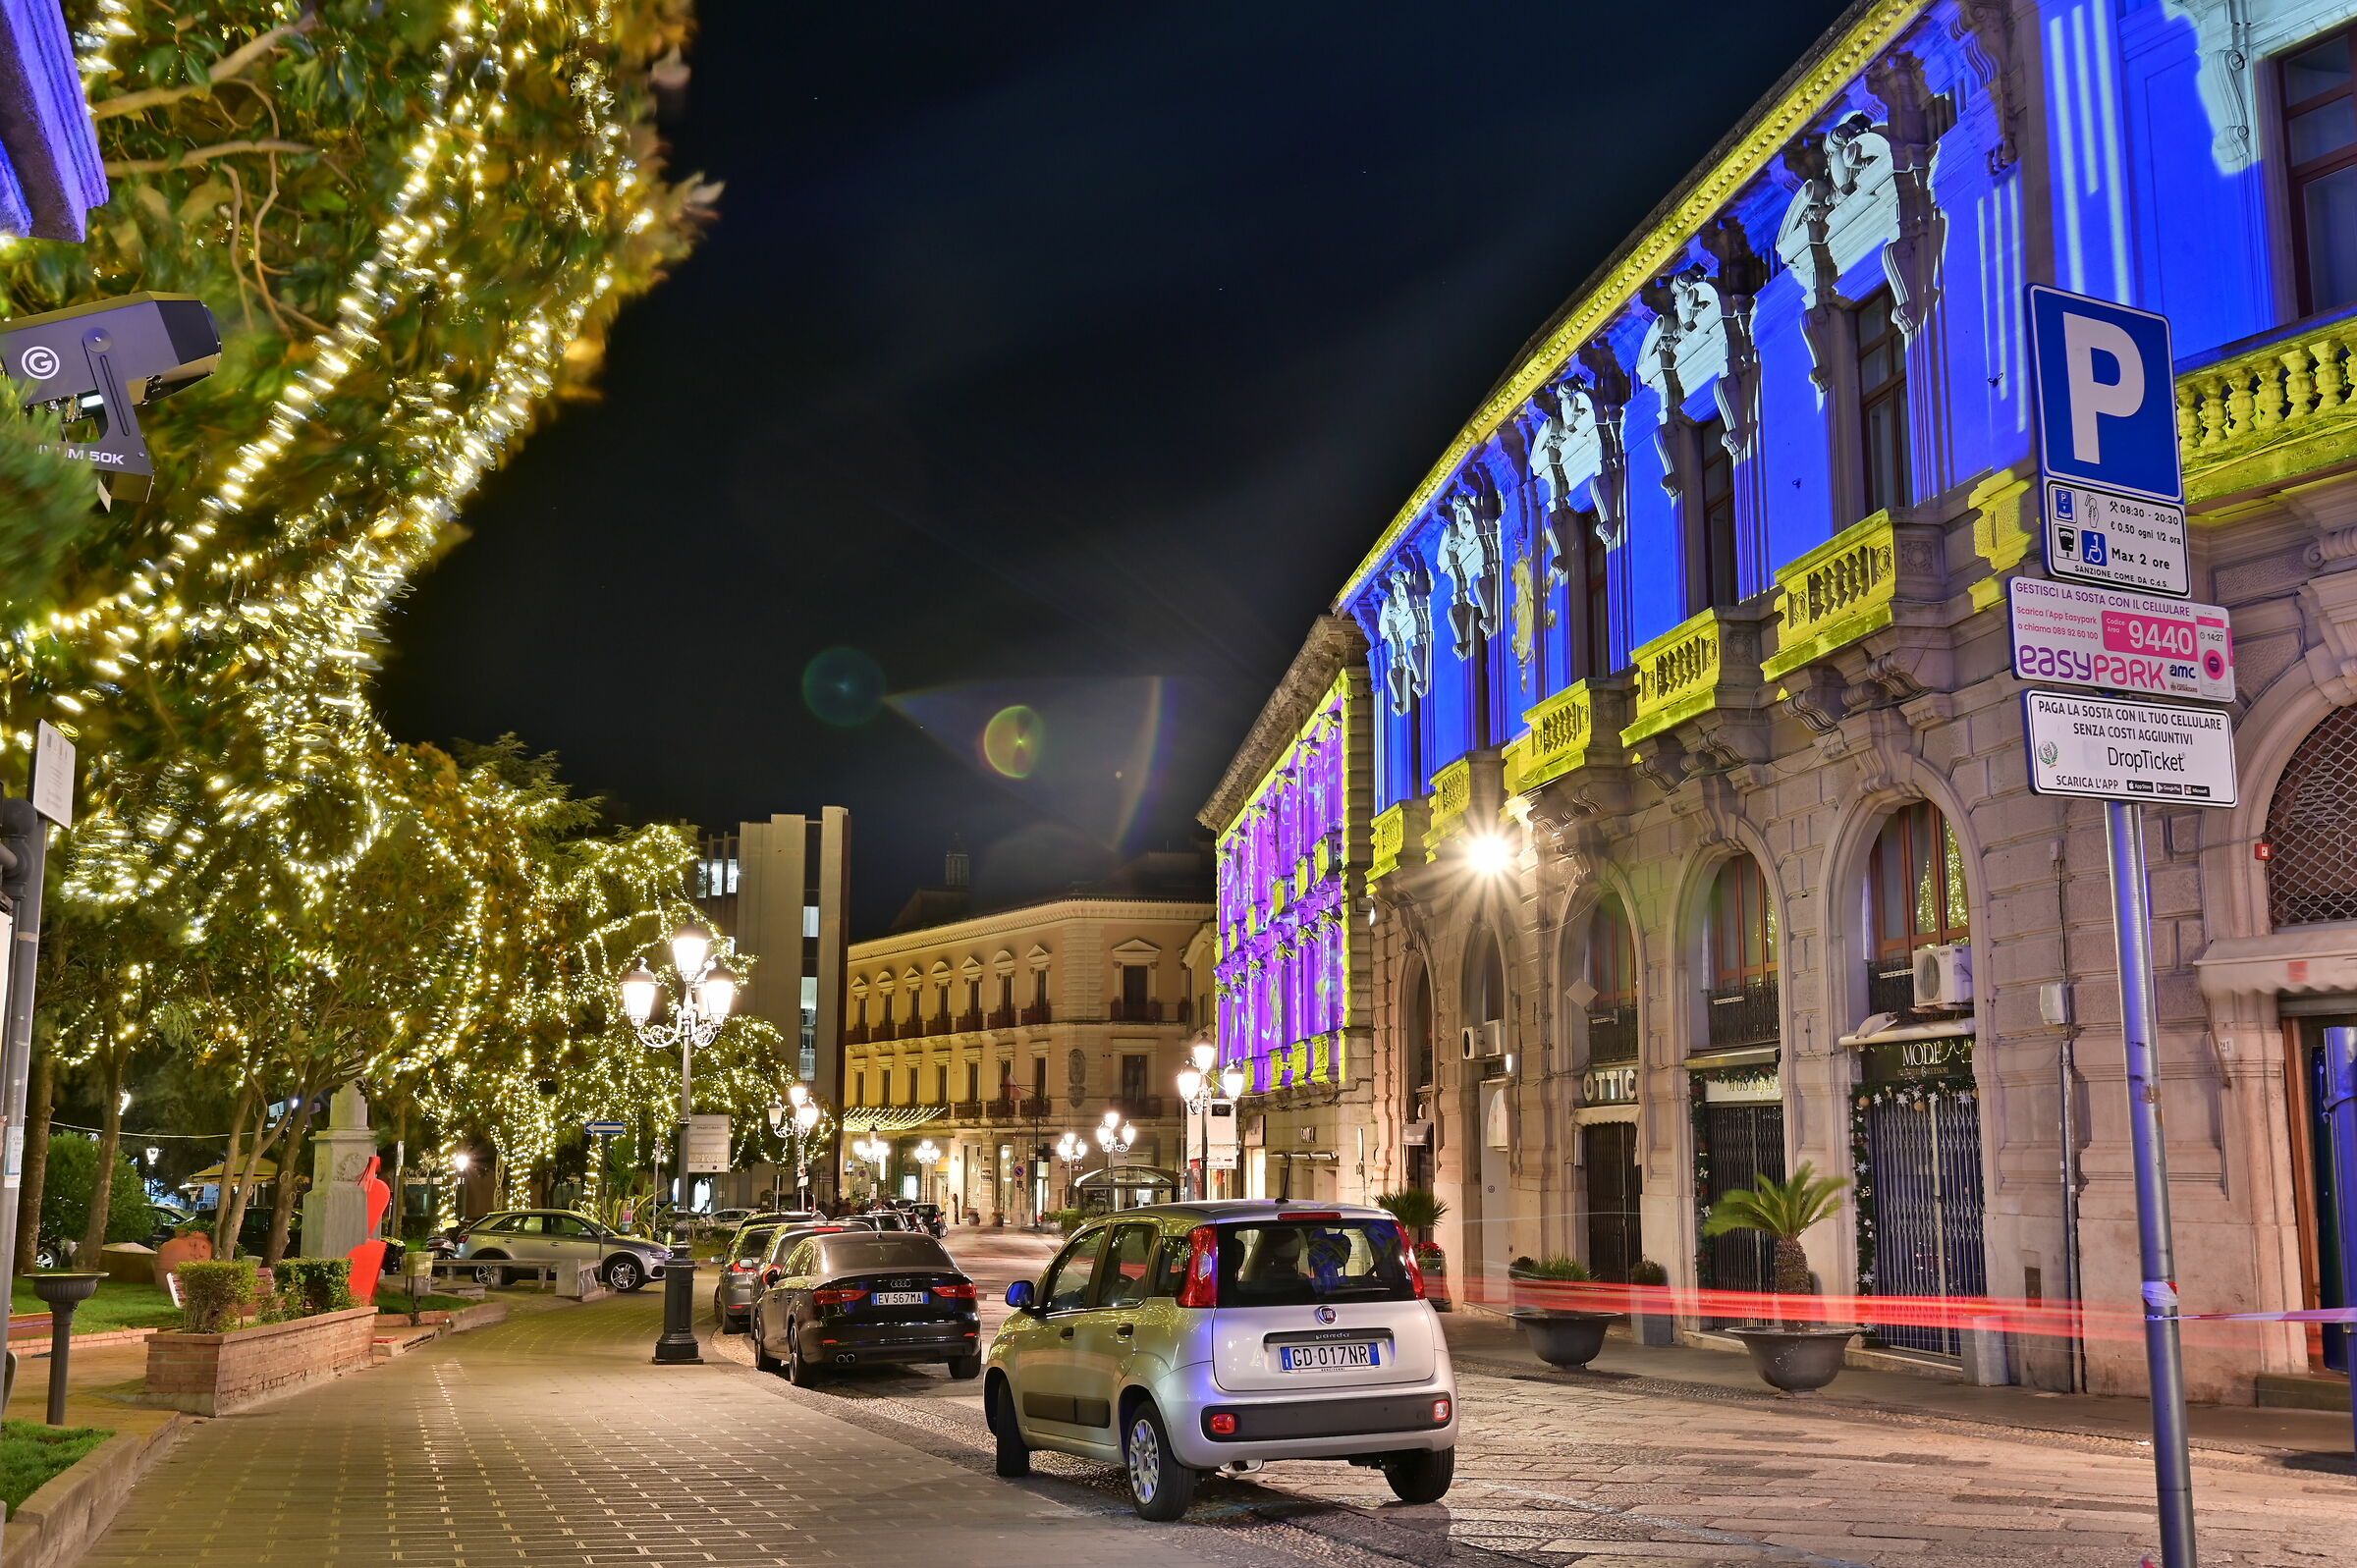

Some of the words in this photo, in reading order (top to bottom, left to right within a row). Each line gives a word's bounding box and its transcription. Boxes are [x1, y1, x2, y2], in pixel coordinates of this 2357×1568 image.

[2062, 311, 2145, 464] P
[89, 451, 125, 465] 50K
[2120, 504, 2145, 518] 08:30
[2154, 513, 2179, 525] 20:30
[2117, 522, 2135, 534] 0.50
[2138, 529, 2154, 539] ogni
[2157, 531, 2166, 542] 1/2
[2169, 536, 2181, 545] ora
[2111, 547, 2135, 564] Max
[2139, 553, 2147, 566] 2
[2153, 559, 2170, 569] ore
[2074, 565, 2111, 578] SANZIONE
[2114, 570, 2135, 582] COME
[2137, 575, 2148, 585] DA
[2150, 578, 2169, 588] C.d.S.
[2015, 582, 2059, 598] GESTISCI
[2061, 589, 2073, 600] LA
[2075, 591, 2106, 605] SOSTA
[2109, 596, 2130, 609] CON
[2133, 599, 2140, 610] IL
[2142, 601, 2190, 617] CELLULARE
[2016, 606, 2044, 617] Scarica
[2046, 609, 2063, 621] l'App
[2065, 613, 2098, 624] Easypark
[2024, 623, 2052, 633] chiama
[2087, 631, 2099, 640] 100
[2128, 620, 2193, 655] 9440
[2169, 664, 2197, 679] amc
[2038, 700, 2065, 715] PAGA
[2067, 703, 2080, 717] LA
[2082, 705, 2113, 720] SOSTA
[2115, 709, 2136, 722] CON
[2138, 711, 2147, 724] IL
[2148, 712, 2168, 725] TUO
[2170, 714, 2221, 730] CELLULARE
[2073, 723, 2106, 737] SENZA
[2108, 726, 2136, 740] COSTI
[2138, 729, 2193, 745] AGGIUNTIVI
[2107, 746, 2185, 773] DropTicket
[2056, 775, 2093, 788] SCARICA
[2095, 778, 2119, 789] L'APP
[1902, 1042, 1942, 1066] MODE
[878, 1294, 890, 1304] EV
[893, 1293, 922, 1304] 567MA
[1292, 1347, 1313, 1367] GD
[1318, 1345, 1369, 1366] 017NR
